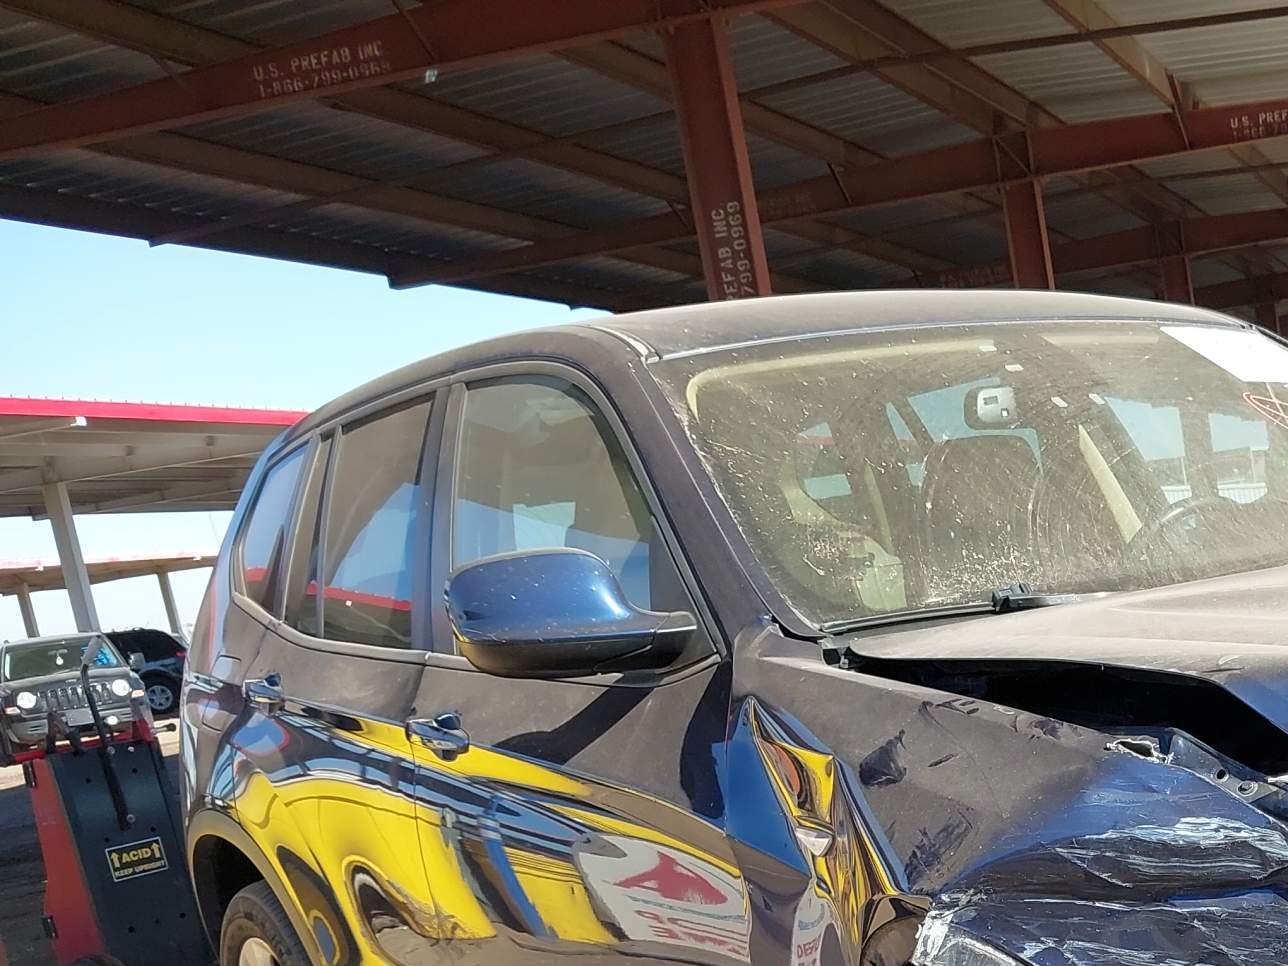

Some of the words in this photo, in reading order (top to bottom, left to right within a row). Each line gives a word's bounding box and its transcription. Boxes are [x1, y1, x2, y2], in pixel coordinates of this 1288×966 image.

[253, 63, 284, 81] U.S.
[290, 47, 352, 74] PREFAB
[357, 40, 383, 60] INC
[1230, 115, 1254, 129] U.S.
[122, 847, 152, 863] ACID
[114, 867, 134, 878] KEEP
